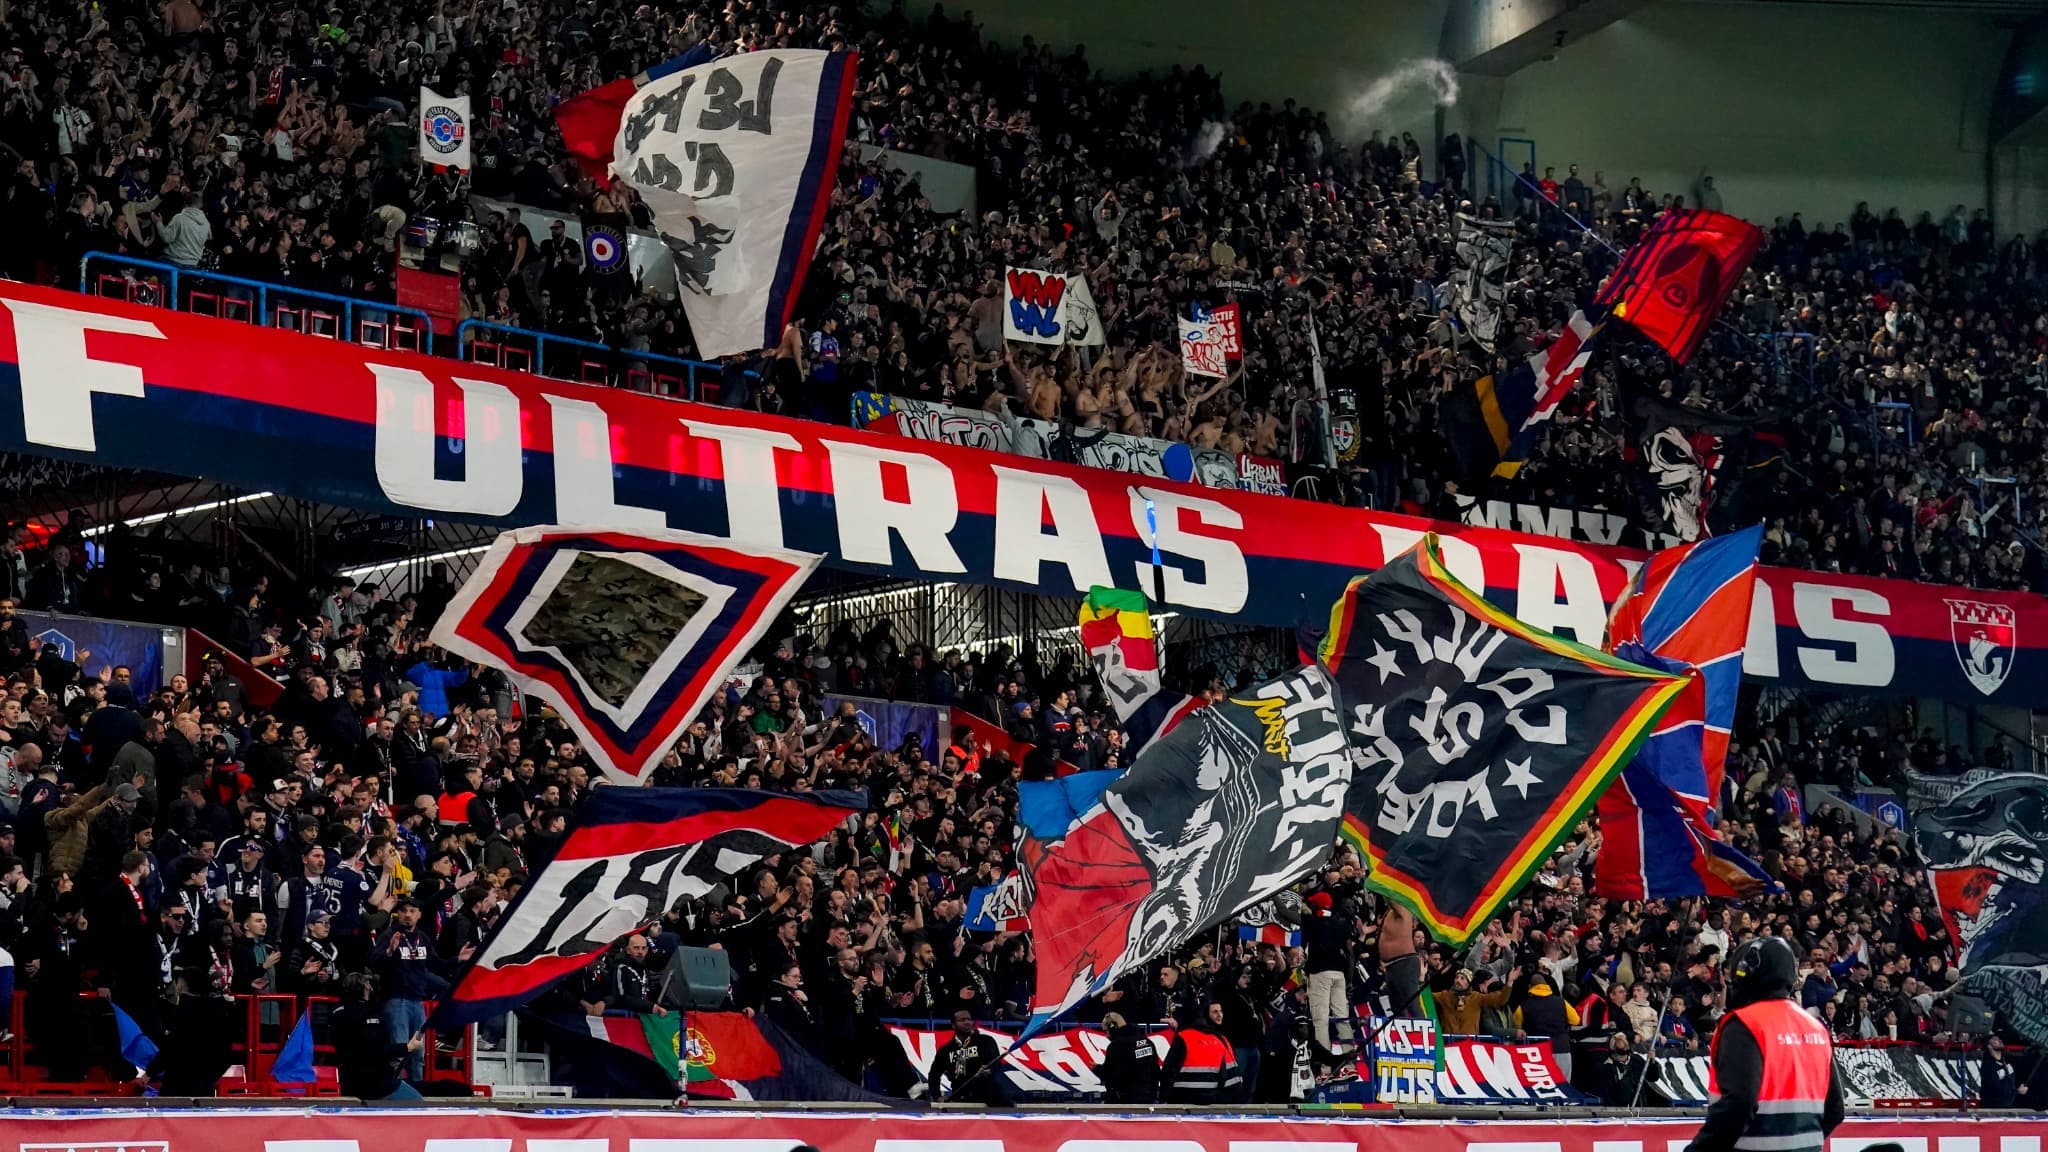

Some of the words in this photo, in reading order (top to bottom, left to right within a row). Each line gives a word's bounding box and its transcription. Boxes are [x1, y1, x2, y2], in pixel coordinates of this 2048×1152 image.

[1006, 267, 1066, 309] VAN
[365, 361, 1250, 614] ULTRAS
[1369, 521, 1896, 688] PAIS
[1374, 1016, 1434, 1056] KST
[1379, 1066, 1435, 1104] UJS
